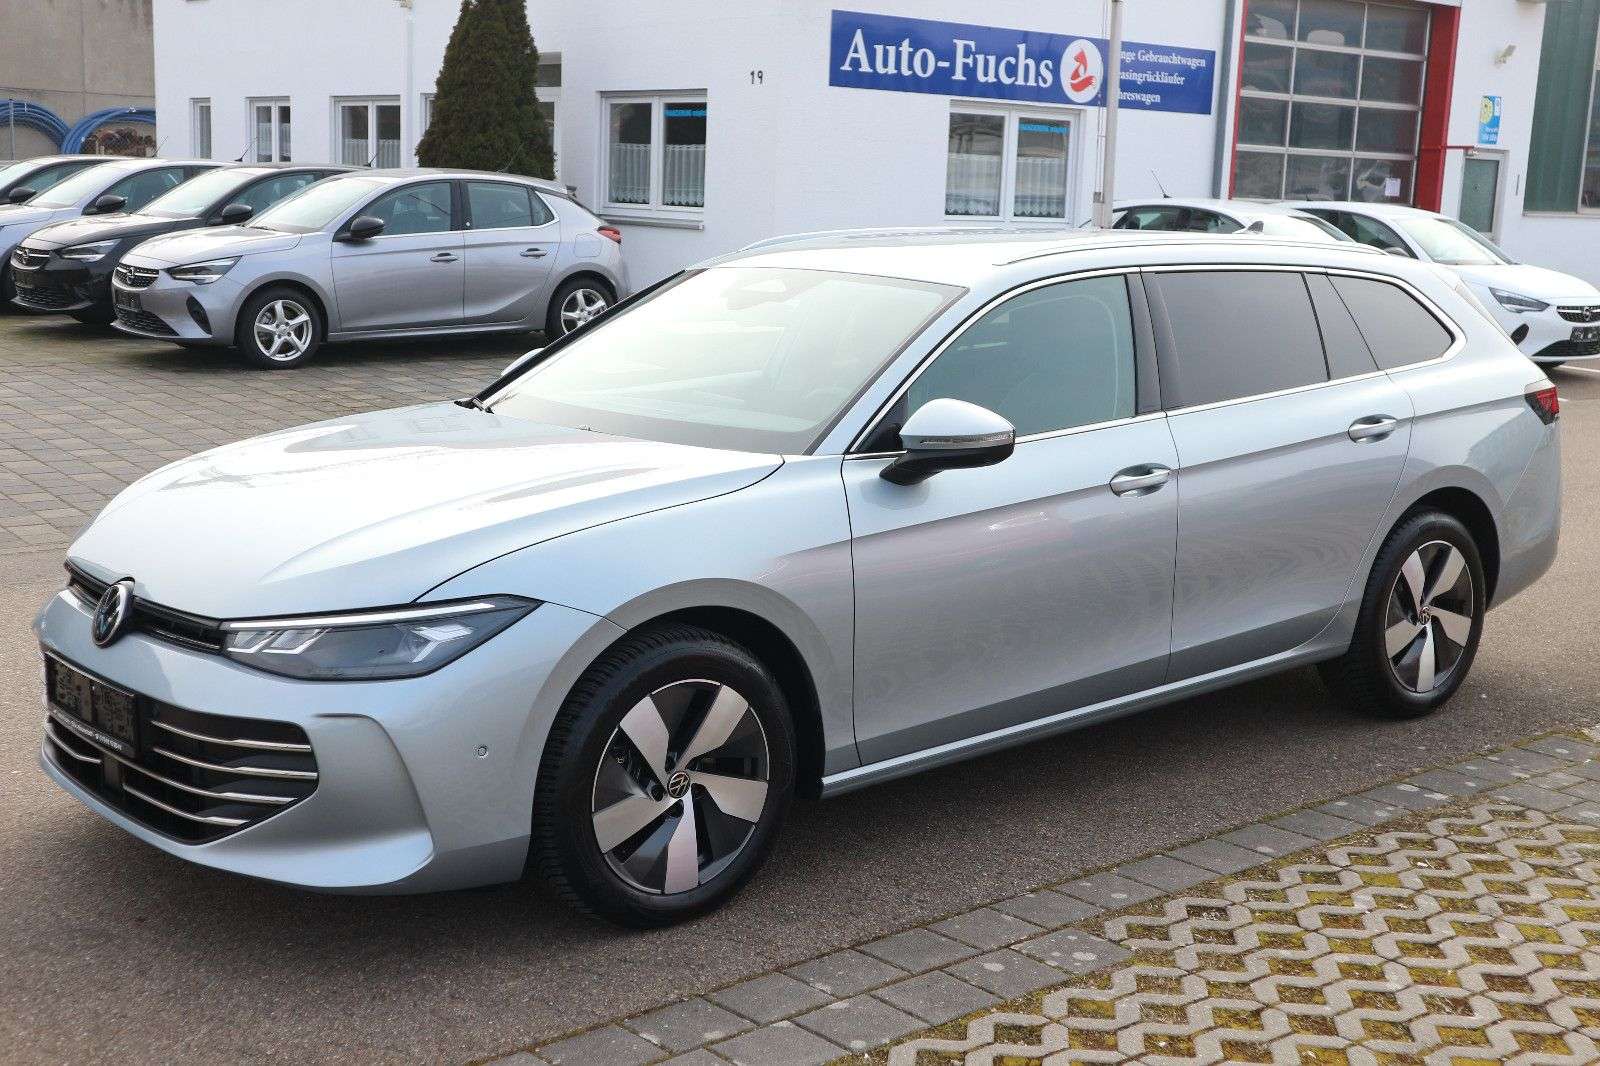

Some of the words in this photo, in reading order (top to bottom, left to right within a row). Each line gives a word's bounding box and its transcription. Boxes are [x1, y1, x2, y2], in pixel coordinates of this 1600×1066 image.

[840, 28, 1053, 87] Auto-Fuchs
[1120, 51, 1135, 63] nge
[1137, 50, 1206, 69] Gebrauchtwagen
[750, 70, 764, 84] 19
[1119, 69, 1185, 85] asingrückläufer
